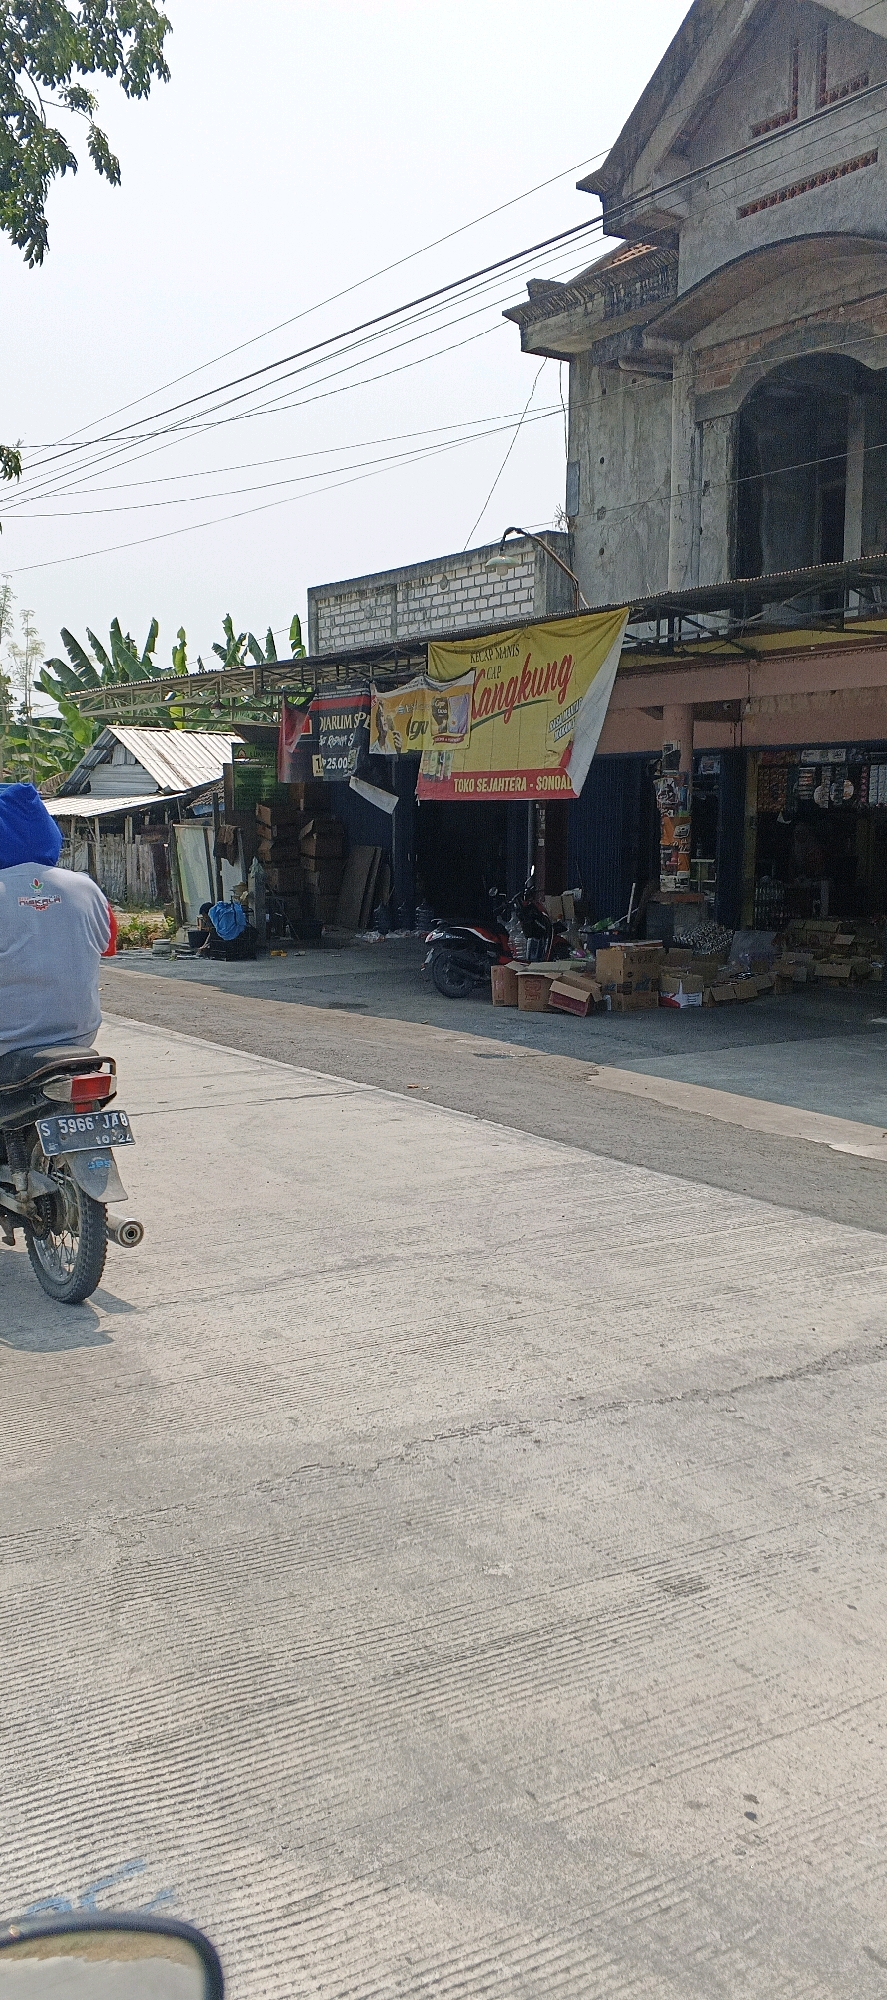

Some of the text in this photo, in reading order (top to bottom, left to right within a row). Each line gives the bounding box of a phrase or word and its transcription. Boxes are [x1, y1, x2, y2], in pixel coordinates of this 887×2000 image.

[470, 643, 520, 663] KECAP MANIS
[486, 665, 502, 680] CAP
[454, 778, 475, 793] TOKO
[476, 776, 527, 793] SEJAHTERA
[40, 1122, 51, 1137] S
[58, 1116, 95, 1134] 5966
